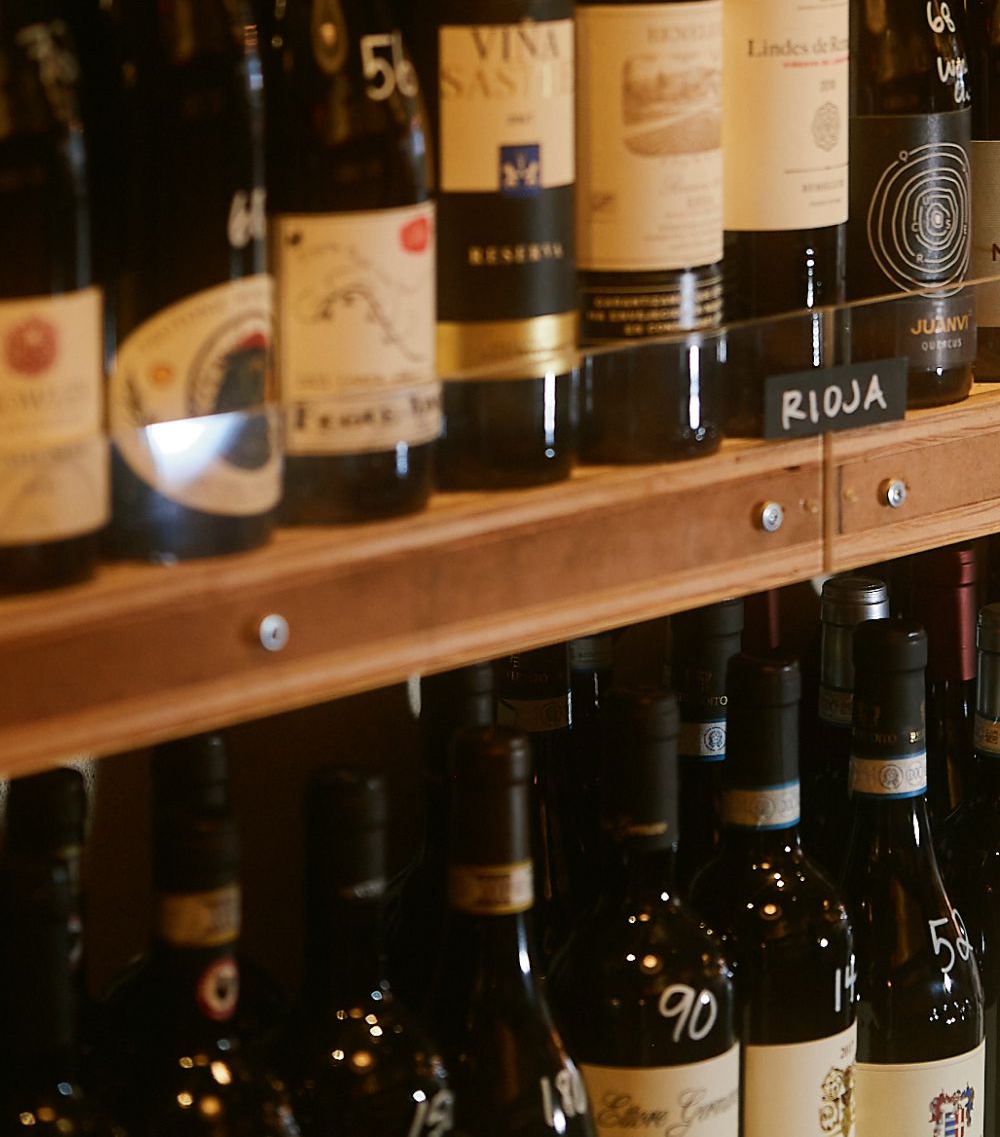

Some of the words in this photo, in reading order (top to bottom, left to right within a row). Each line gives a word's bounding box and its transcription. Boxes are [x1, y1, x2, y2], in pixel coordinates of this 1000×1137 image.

[926, 0, 957, 33] 68
[910, 315, 969, 336] JUANVI
[782, 373, 888, 431] RIOJA
[658, 983, 718, 1044] 90
